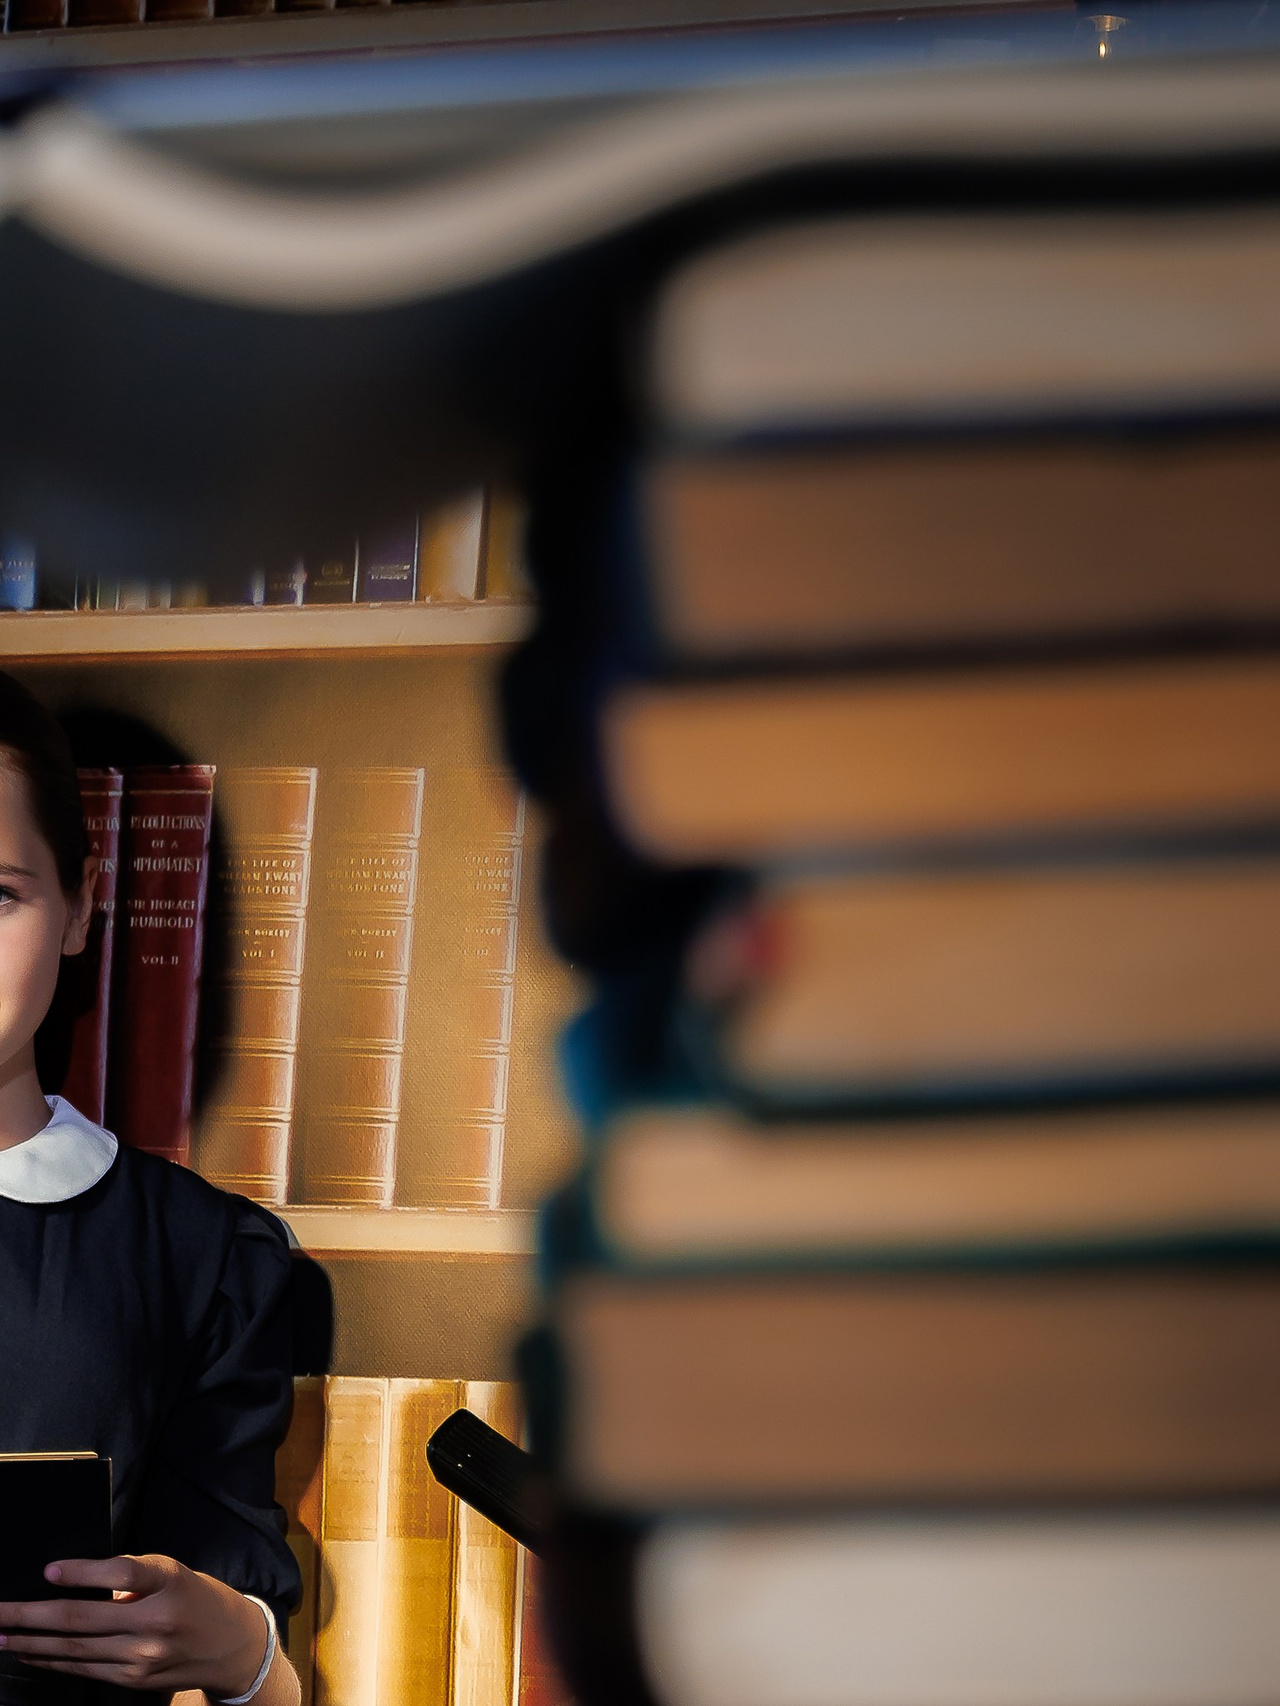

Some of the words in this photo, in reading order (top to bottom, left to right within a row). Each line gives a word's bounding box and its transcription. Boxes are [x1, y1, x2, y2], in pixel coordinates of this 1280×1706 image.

[130, 815, 206, 830] RECOLLECTIONS
[170, 839, 179, 848] A
[130, 857, 202, 872] DIPLOMATIST
[150, 900, 196, 911] HORACE
[130, 917, 194, 928] RUMBOLD
